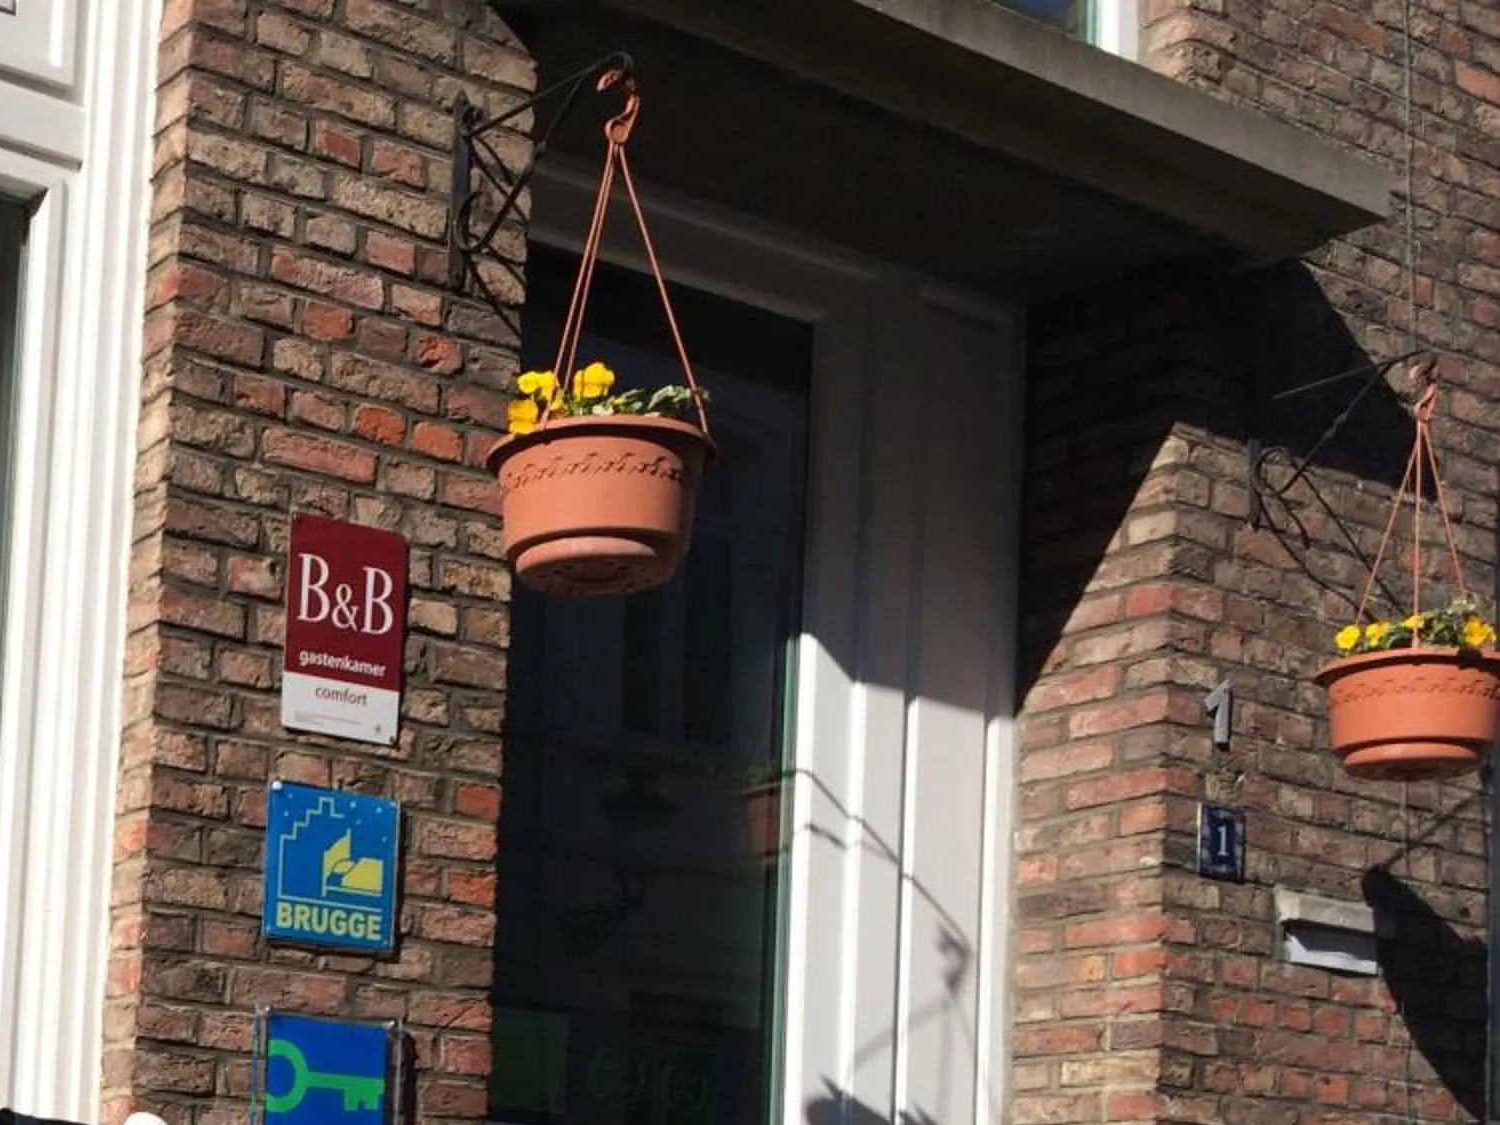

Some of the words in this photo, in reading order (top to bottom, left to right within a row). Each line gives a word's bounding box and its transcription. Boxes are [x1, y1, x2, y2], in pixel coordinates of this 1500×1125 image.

[296, 552, 394, 636] B&B
[299, 649, 386, 678] gastenkamer
[314, 684, 368, 707] comfort
[1203, 677, 1234, 744] 1
[1217, 826, 1229, 857] 1
[275, 901, 383, 941] BRUGGE
